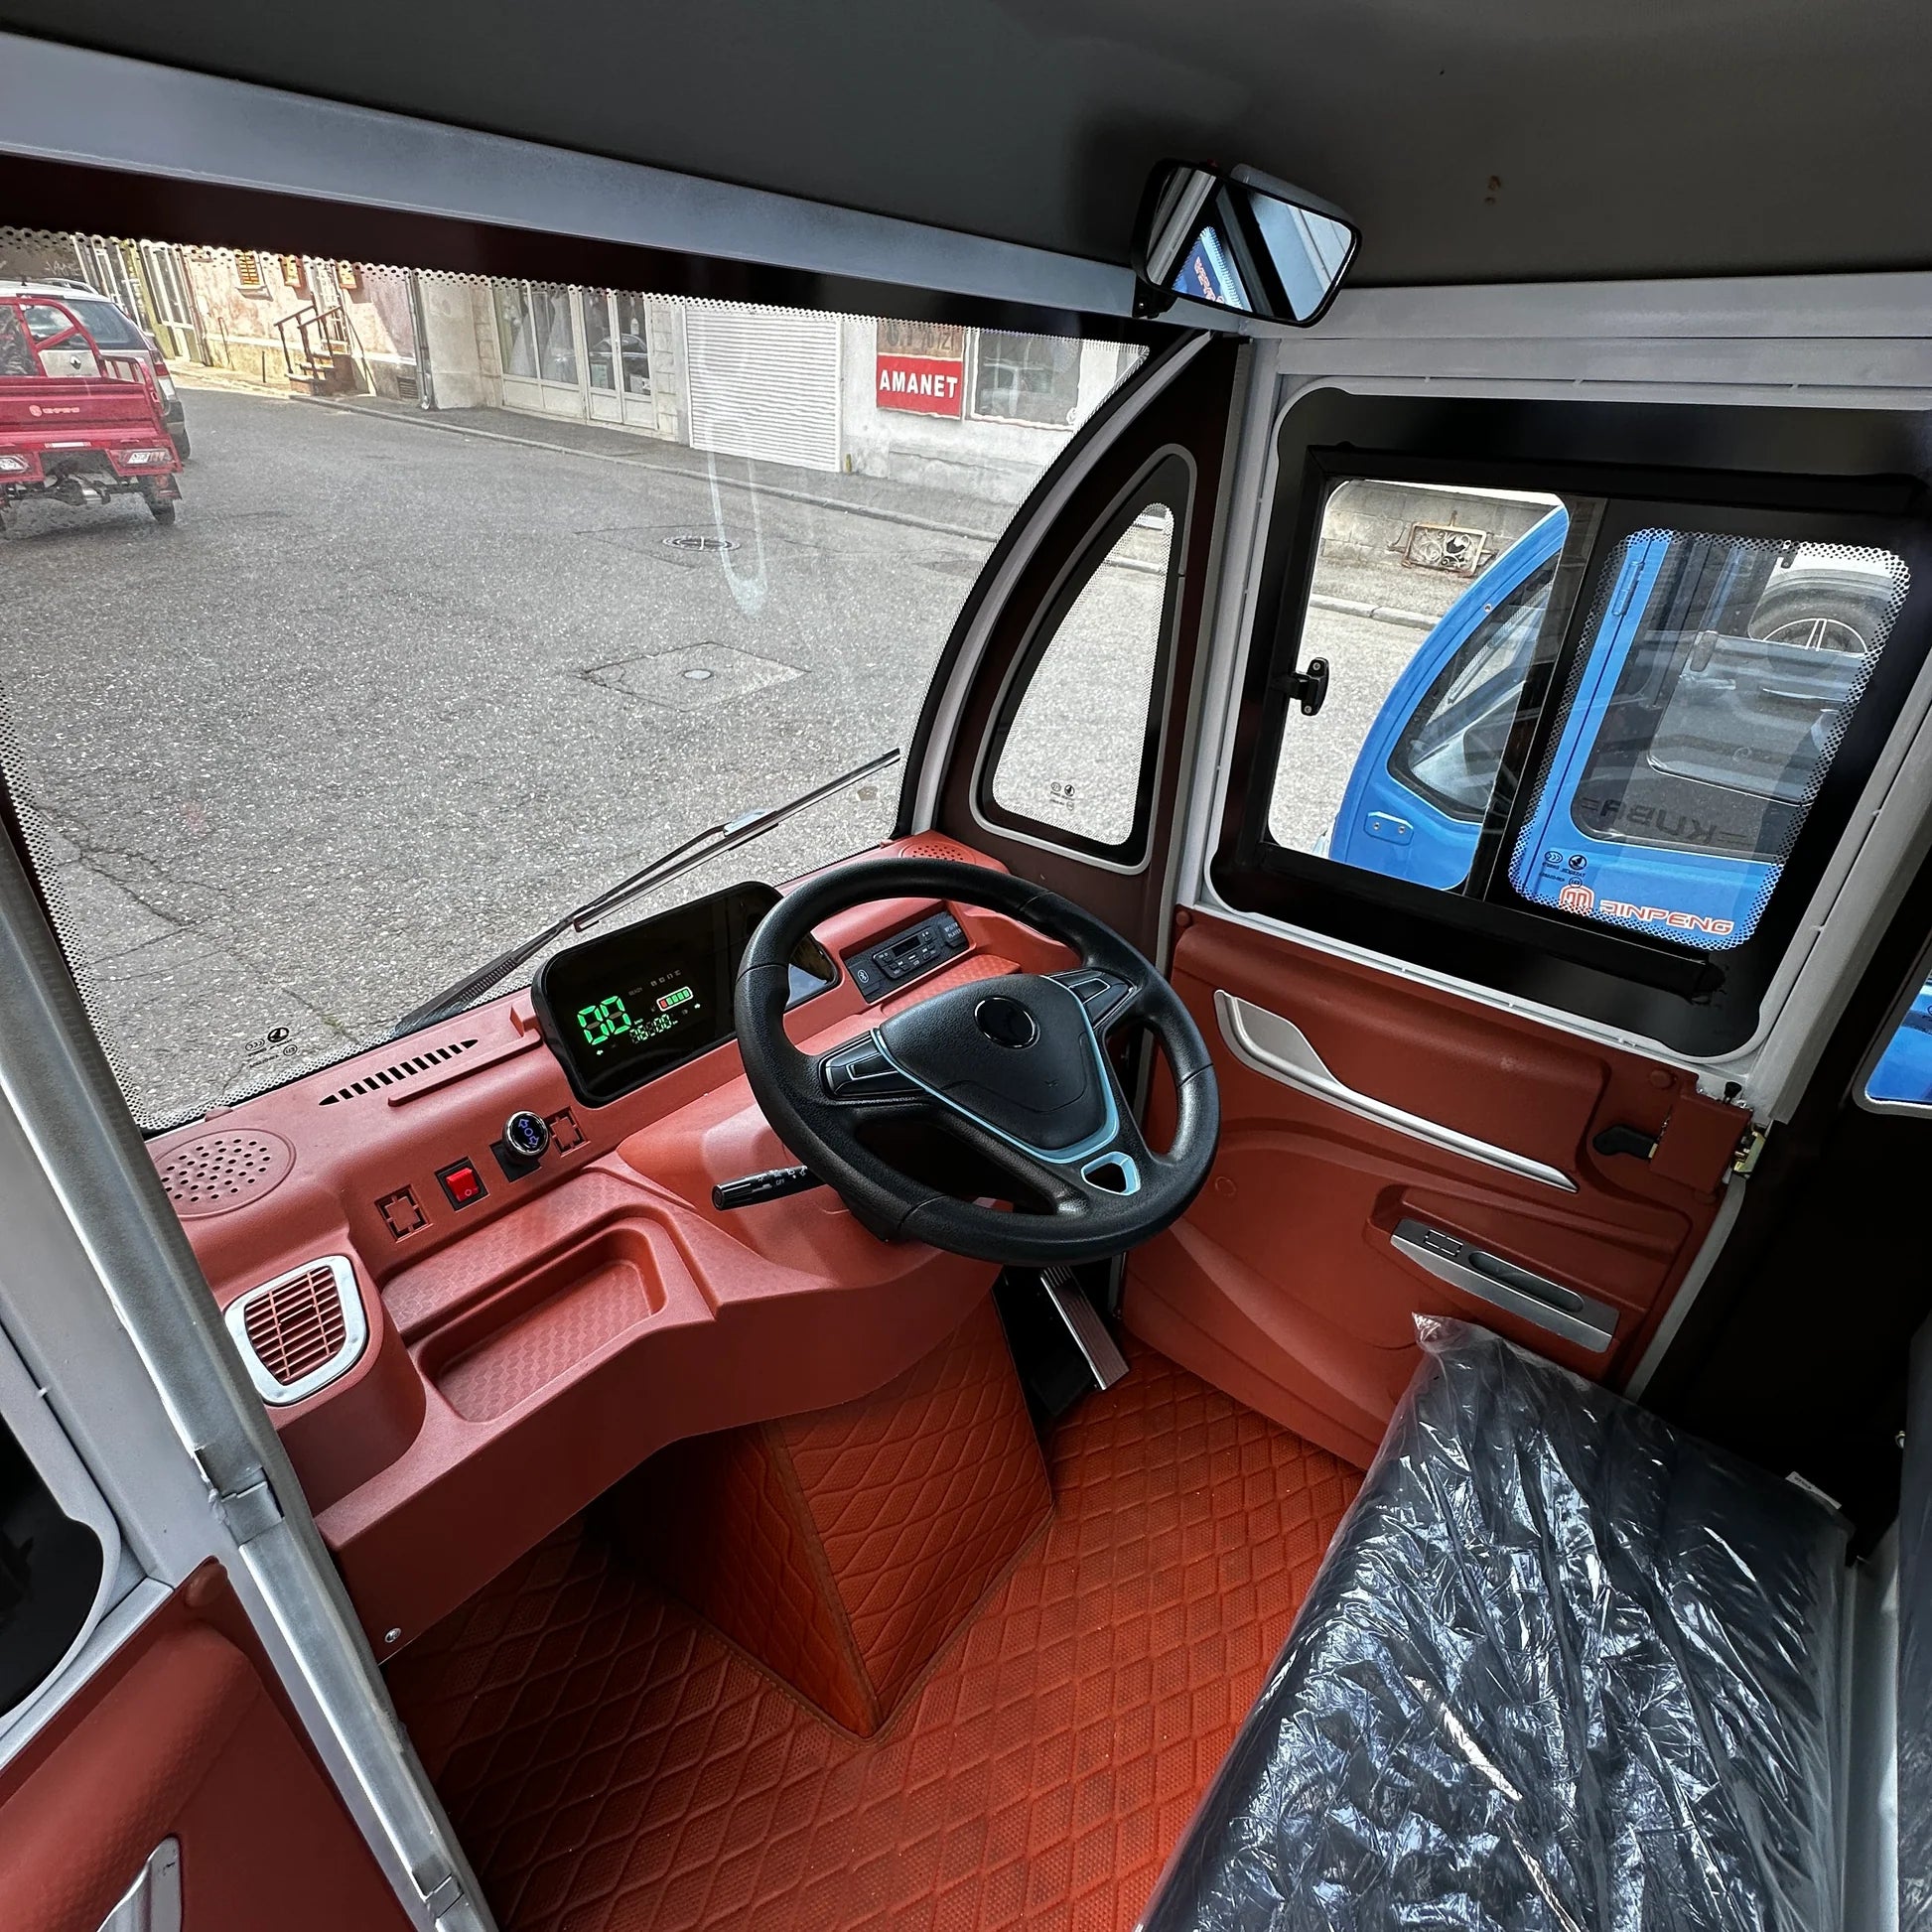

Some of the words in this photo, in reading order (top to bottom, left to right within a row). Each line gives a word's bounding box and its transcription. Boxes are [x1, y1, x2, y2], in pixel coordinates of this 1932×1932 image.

[879, 368, 958, 399] AMANET
[1599, 898, 1735, 936] JINPENG
[577, 996, 632, 1045] 00
